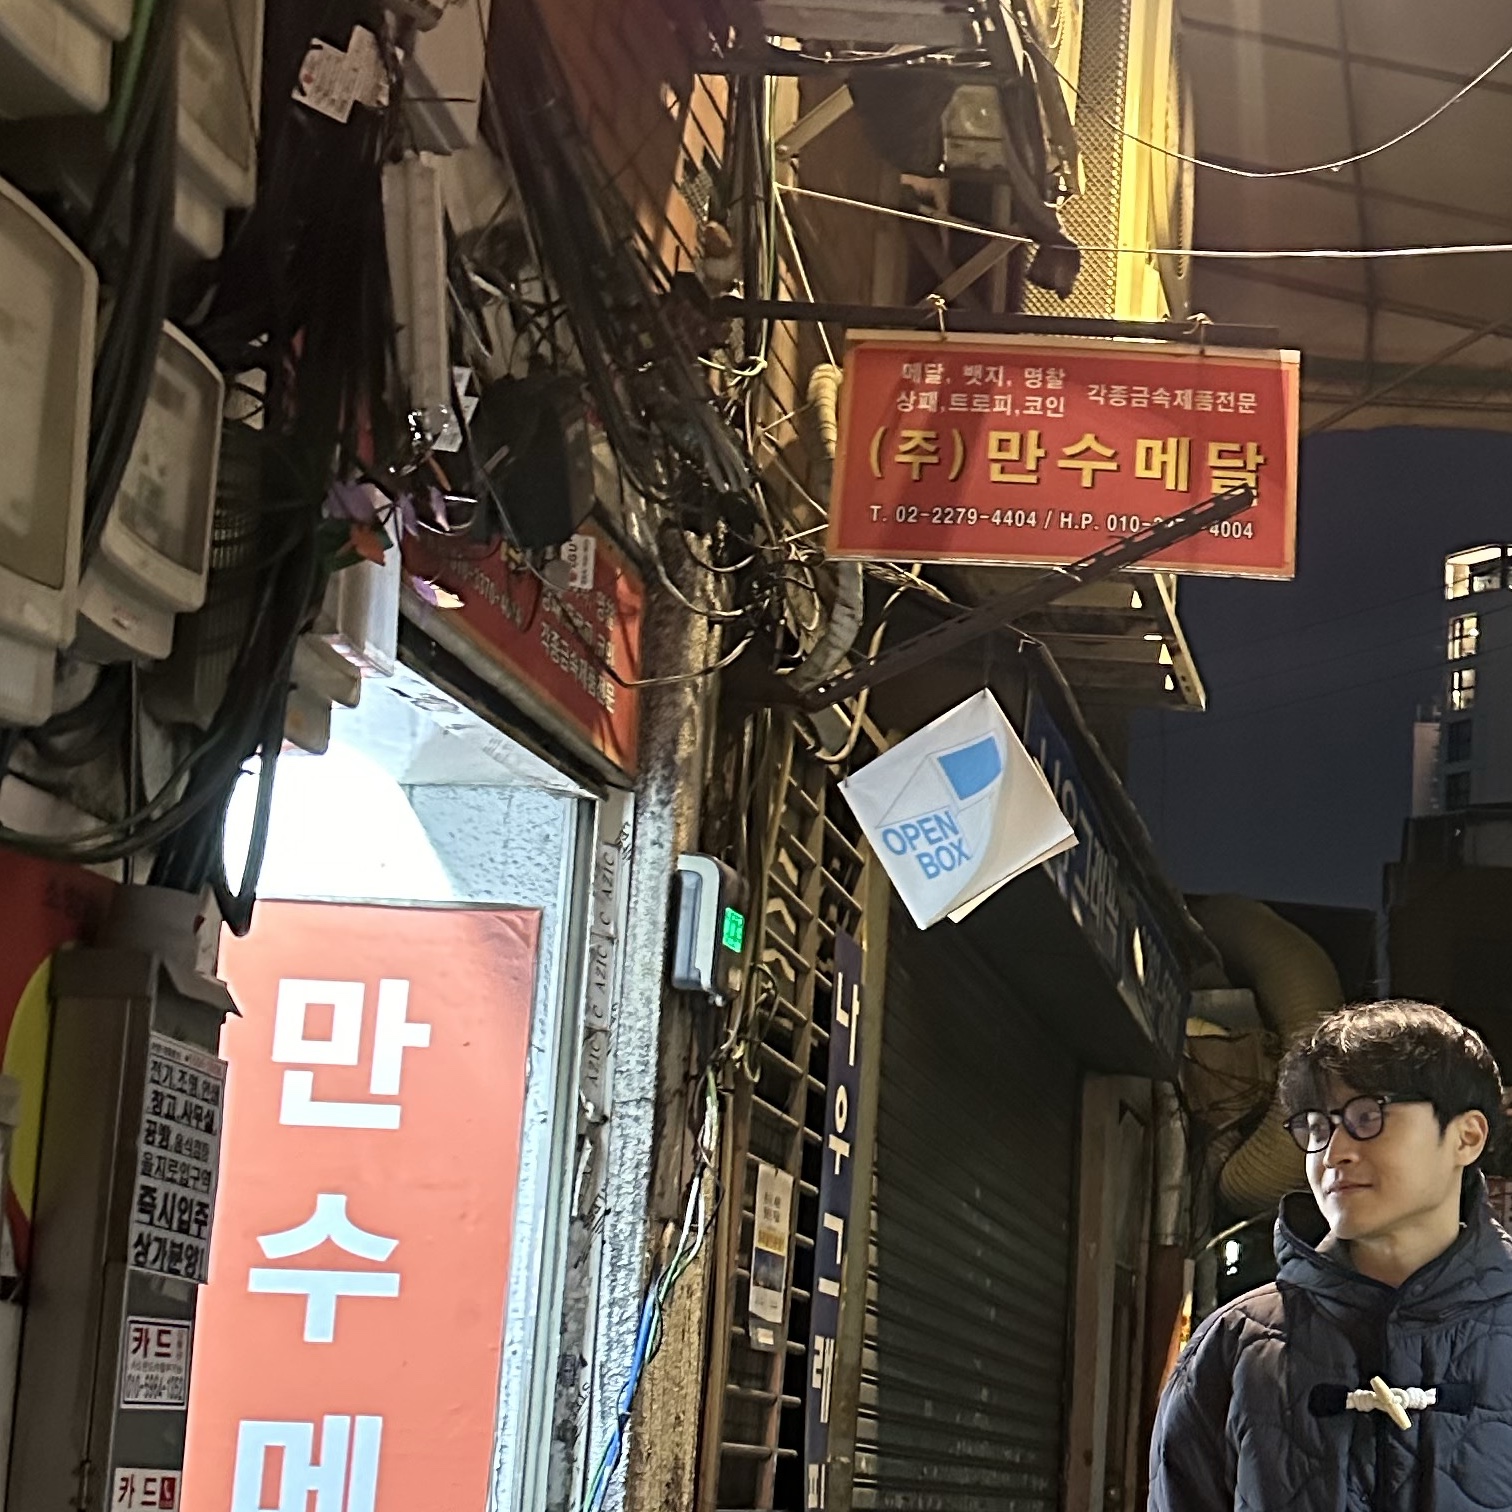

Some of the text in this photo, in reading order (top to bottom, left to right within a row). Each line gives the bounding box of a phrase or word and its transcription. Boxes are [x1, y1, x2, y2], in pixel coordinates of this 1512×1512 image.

[1024, 366, 1066, 390] 명찰
[1086, 383, 1258, 415] 각종금속제품전문
[869, 426, 967, 483] (주)
[870, 505, 888, 523] T.
[895, 505, 1038, 529] 02-2279-4404
[1059, 511, 1100, 532] H.P.
[881, 810, 960, 856] OPEN
[916, 838, 971, 880] BOX
[131, 1327, 171, 1359] 카드
[117, 1473, 157, 1509] 카드
